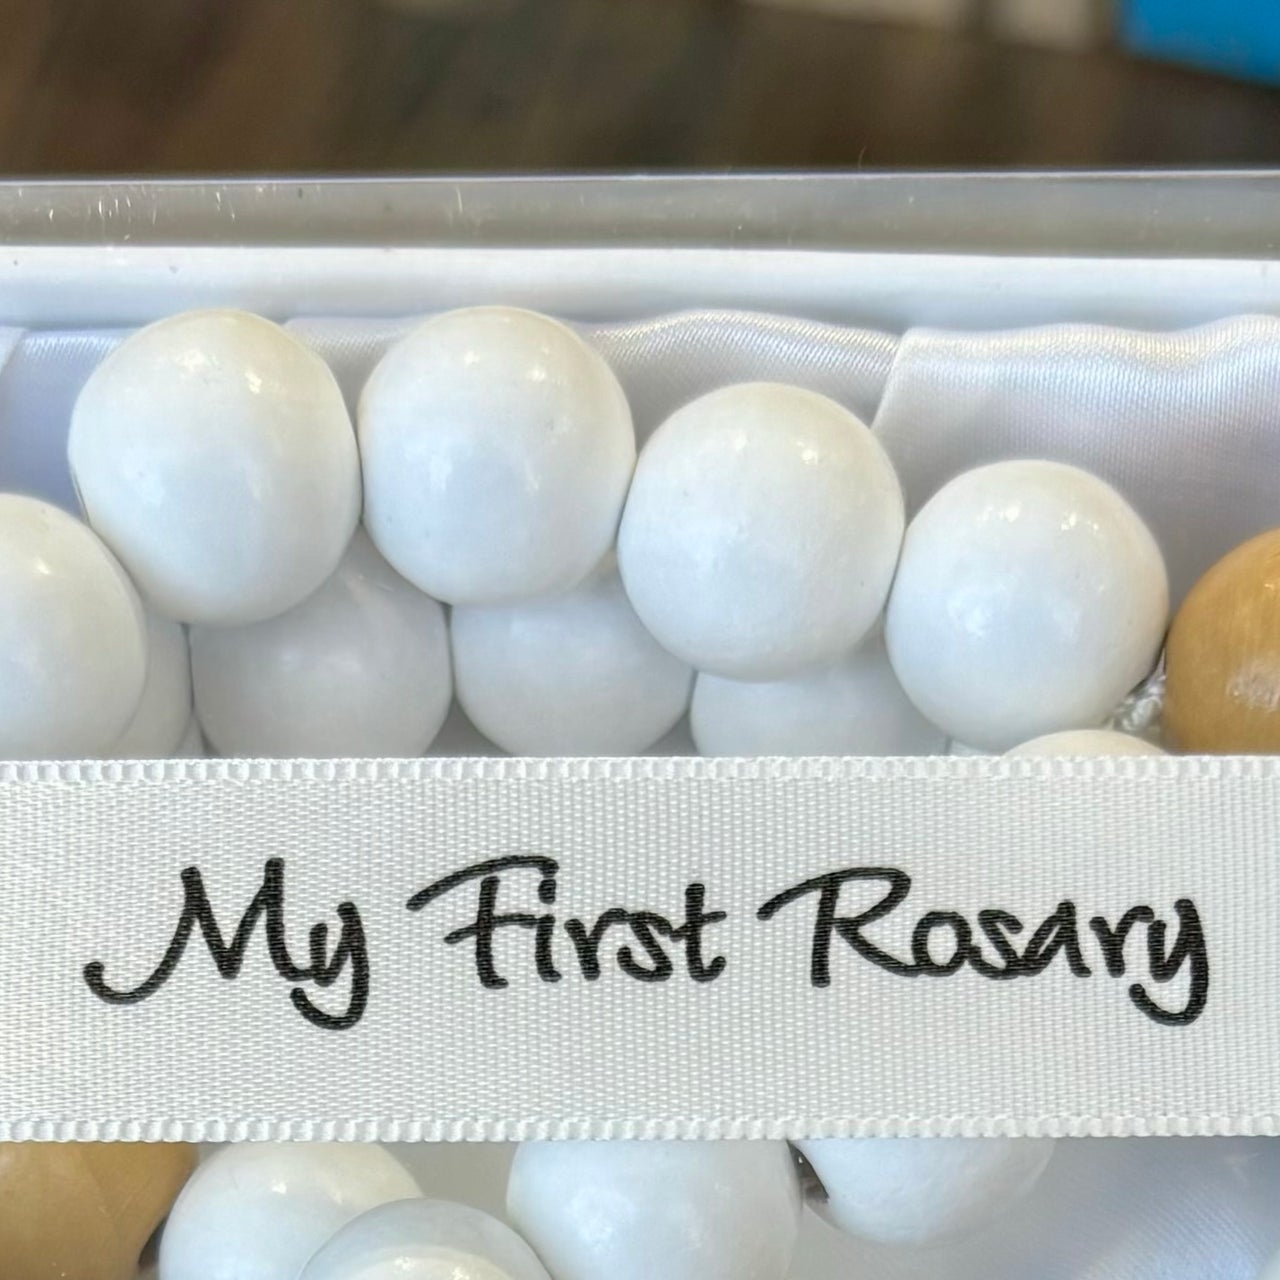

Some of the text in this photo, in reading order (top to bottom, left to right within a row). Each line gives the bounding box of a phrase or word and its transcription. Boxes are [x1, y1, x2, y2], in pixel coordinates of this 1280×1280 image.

[82, 854, 1209, 1032] My First Rosary
